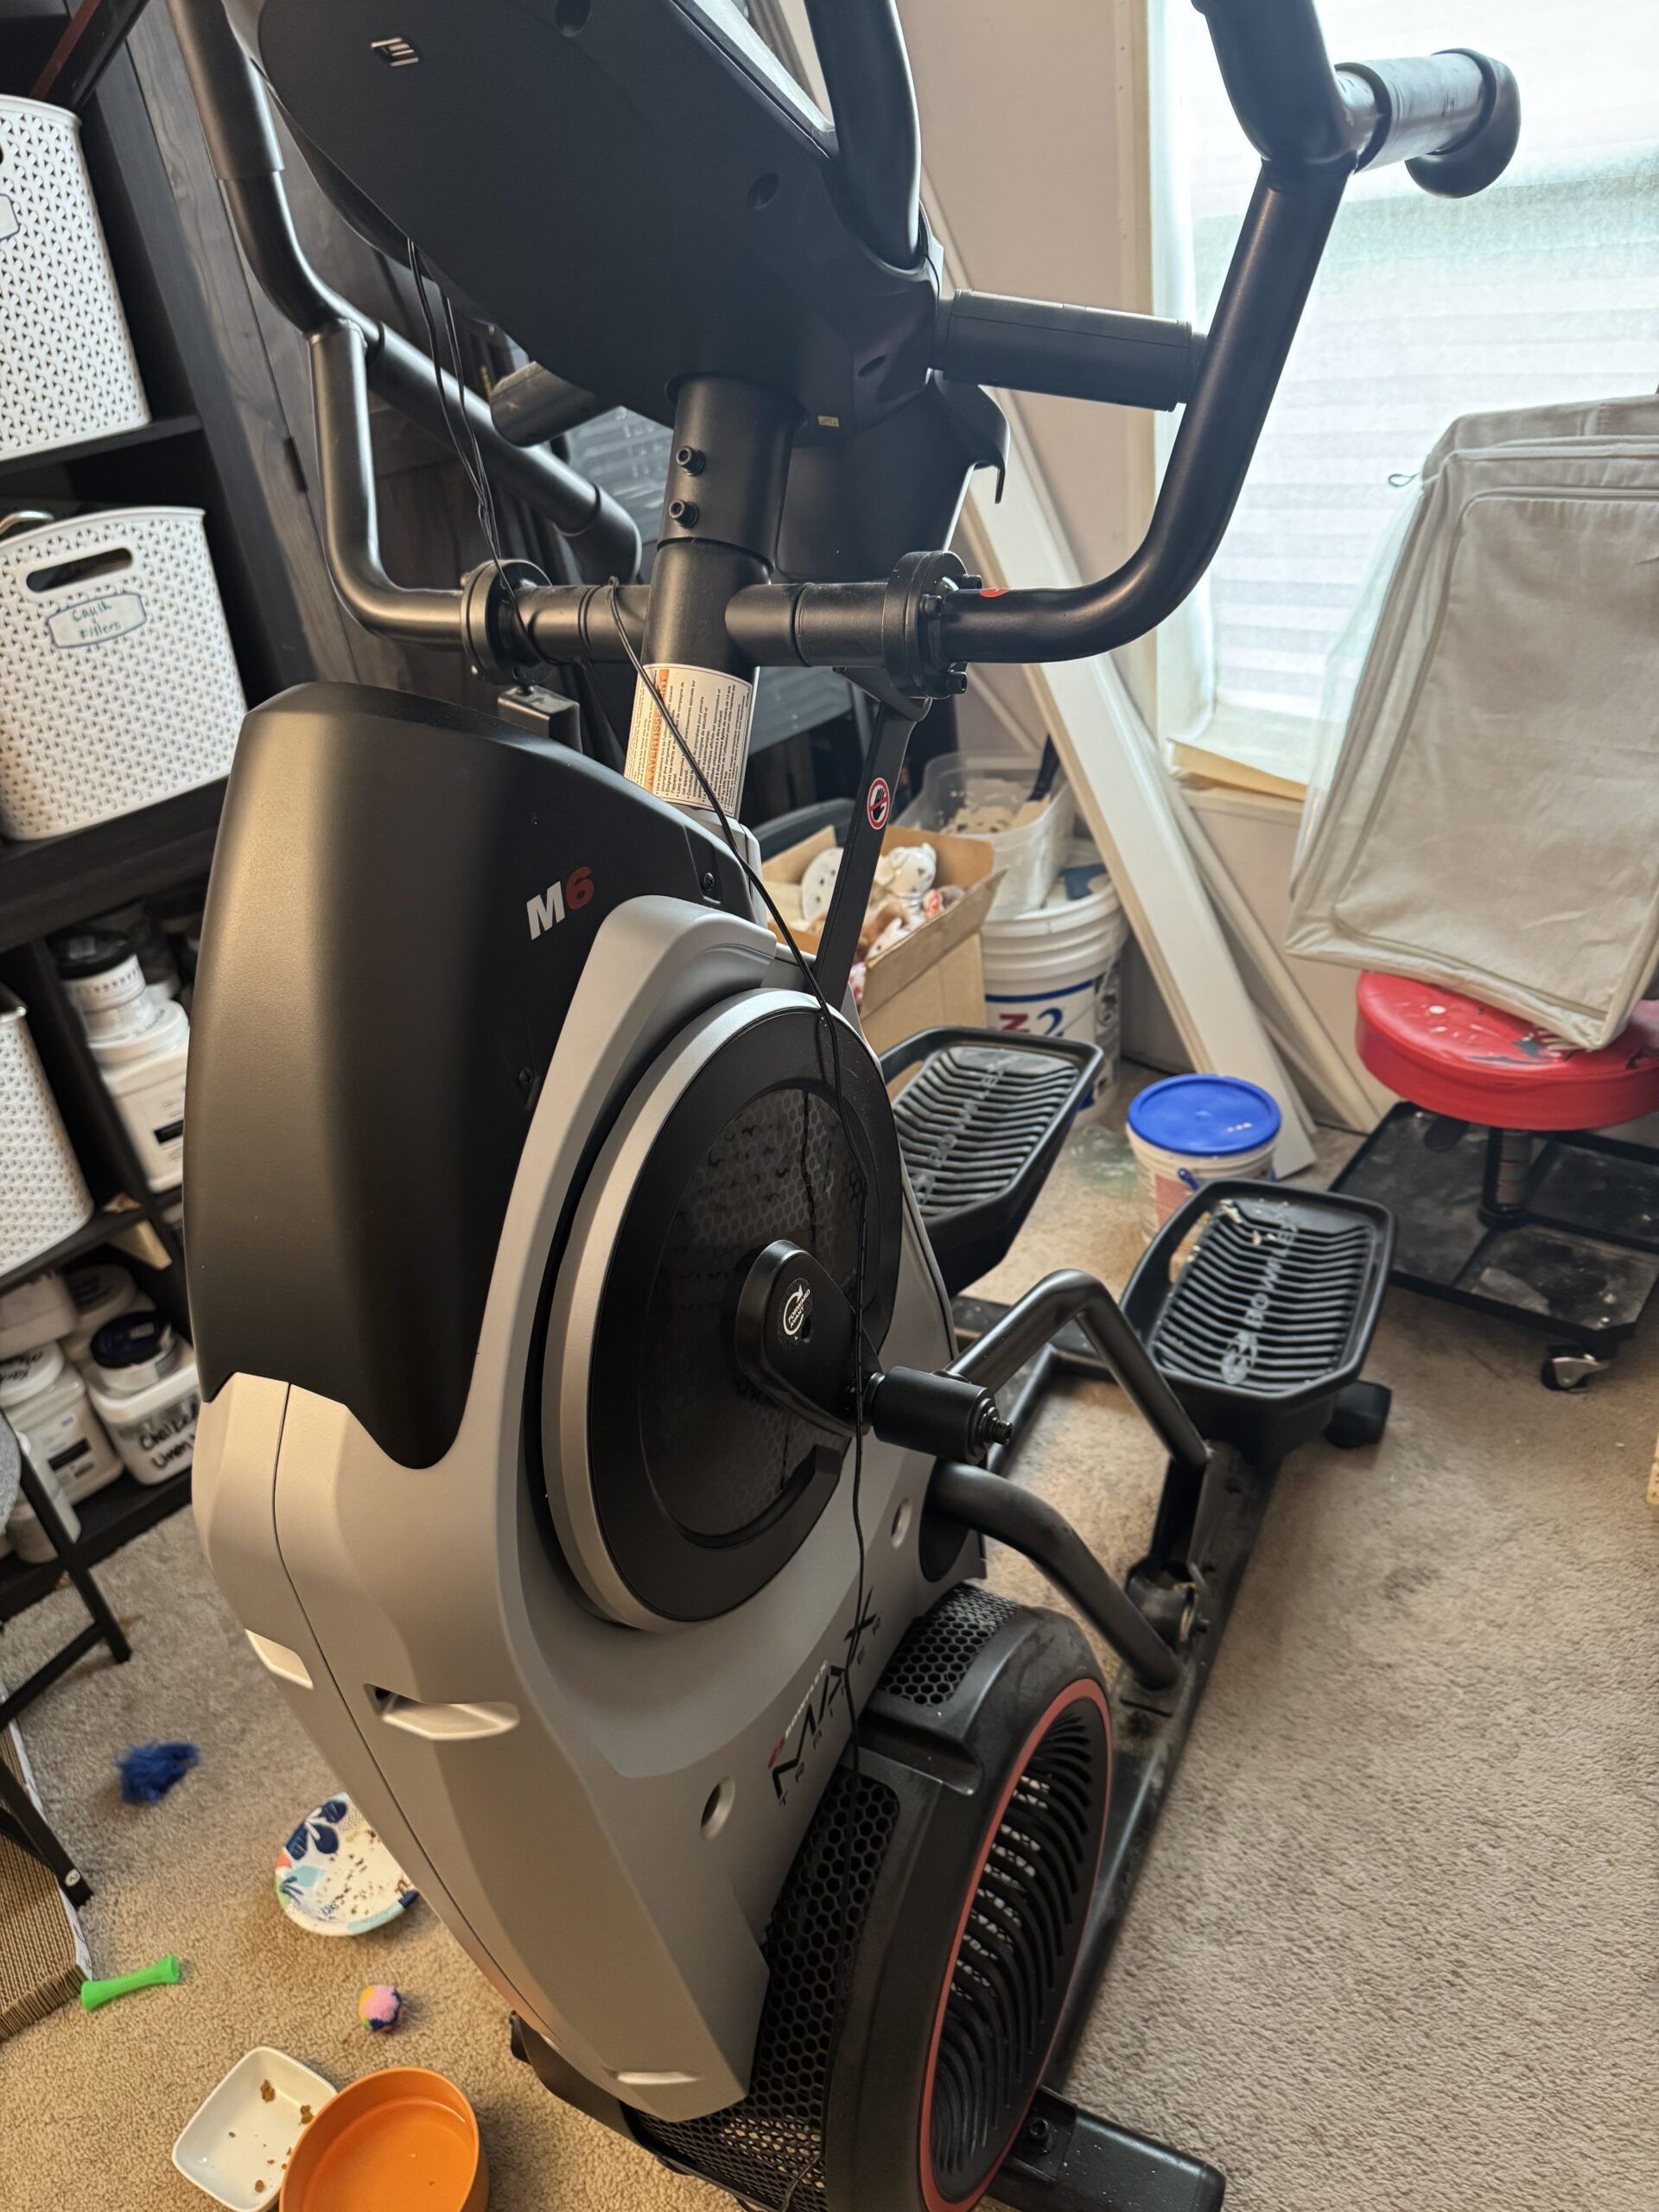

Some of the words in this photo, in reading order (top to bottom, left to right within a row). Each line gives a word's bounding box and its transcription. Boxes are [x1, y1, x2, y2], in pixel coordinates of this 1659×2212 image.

[526, 866, 594, 941] M6
[788, 1288, 810, 1323] FORWARD
[790, 1305, 804, 1329] AVANT
[772, 1586, 877, 1800] MAX
